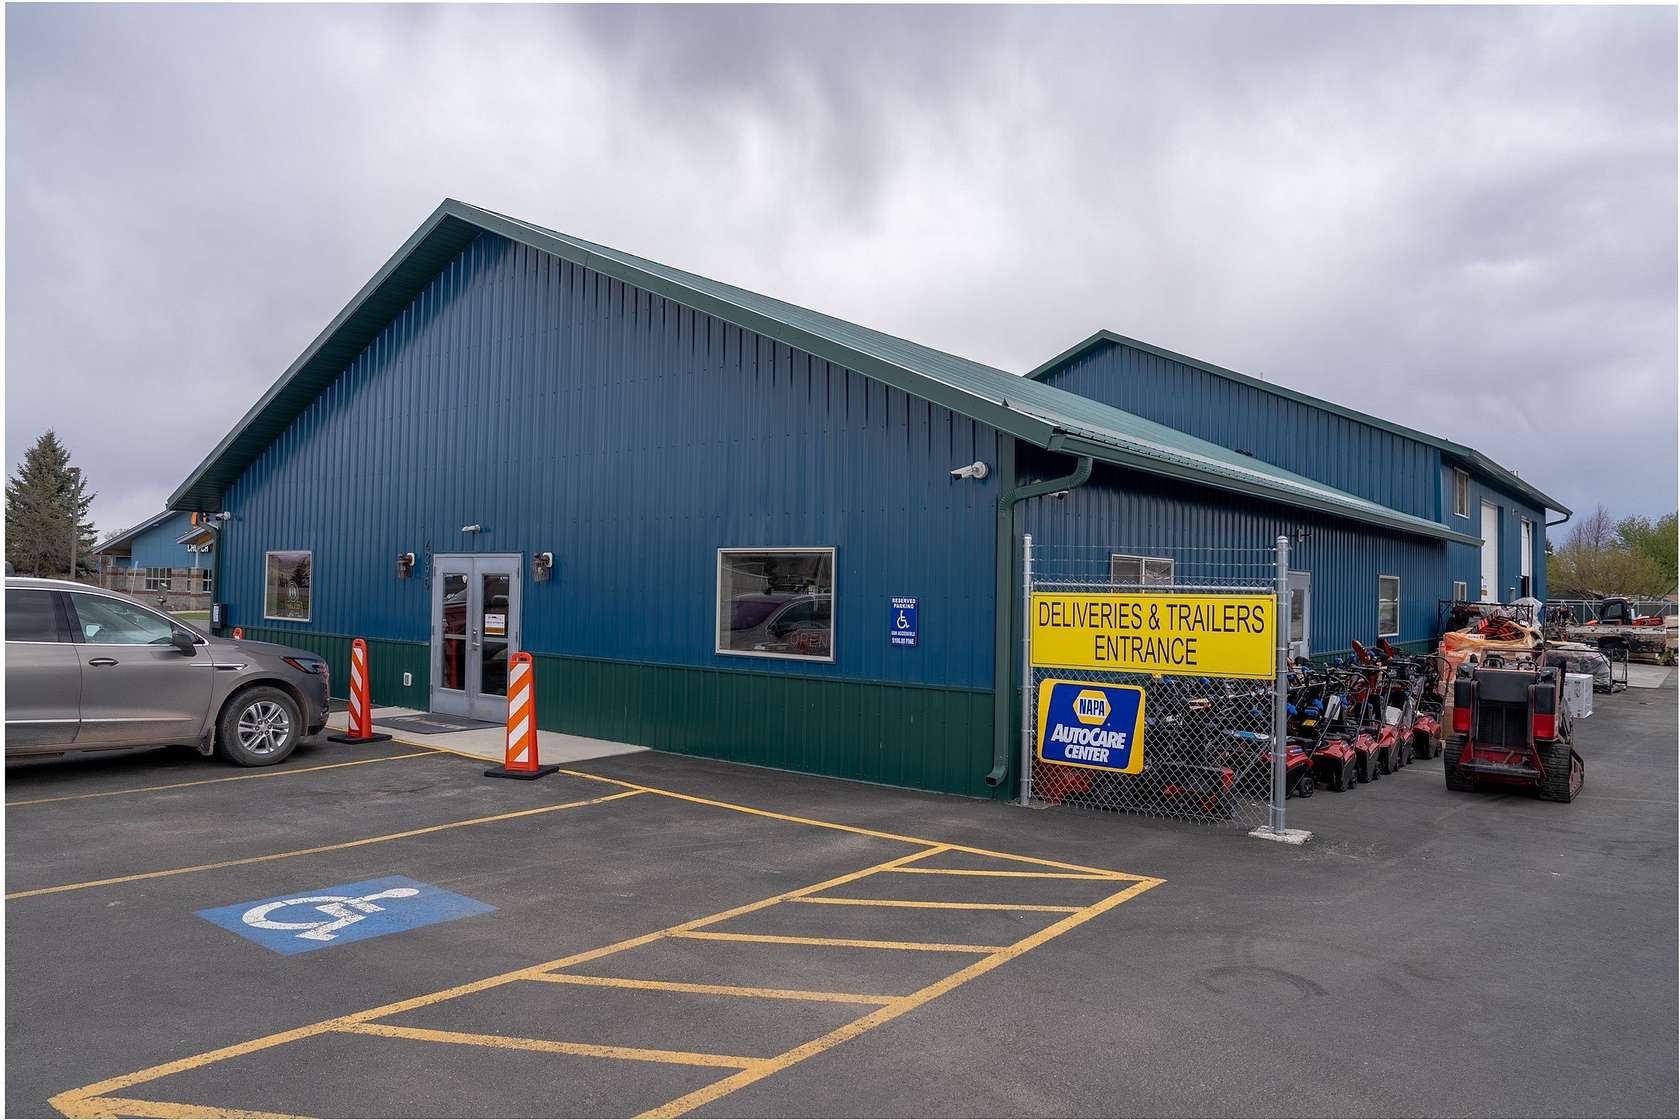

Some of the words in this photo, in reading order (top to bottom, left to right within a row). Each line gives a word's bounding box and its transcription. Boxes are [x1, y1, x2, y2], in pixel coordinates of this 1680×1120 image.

[187, 544, 209, 552] CHUCH
[1039, 601, 1142, 630] DELIVERIES
[1148, 603, 1160, 630] &
[1166, 604, 1265, 634] TRAILERS
[1095, 635, 1197, 665] ENTRANCE
[1079, 698, 1105, 717] NAPA
[1064, 744, 1108, 763] CENTER
